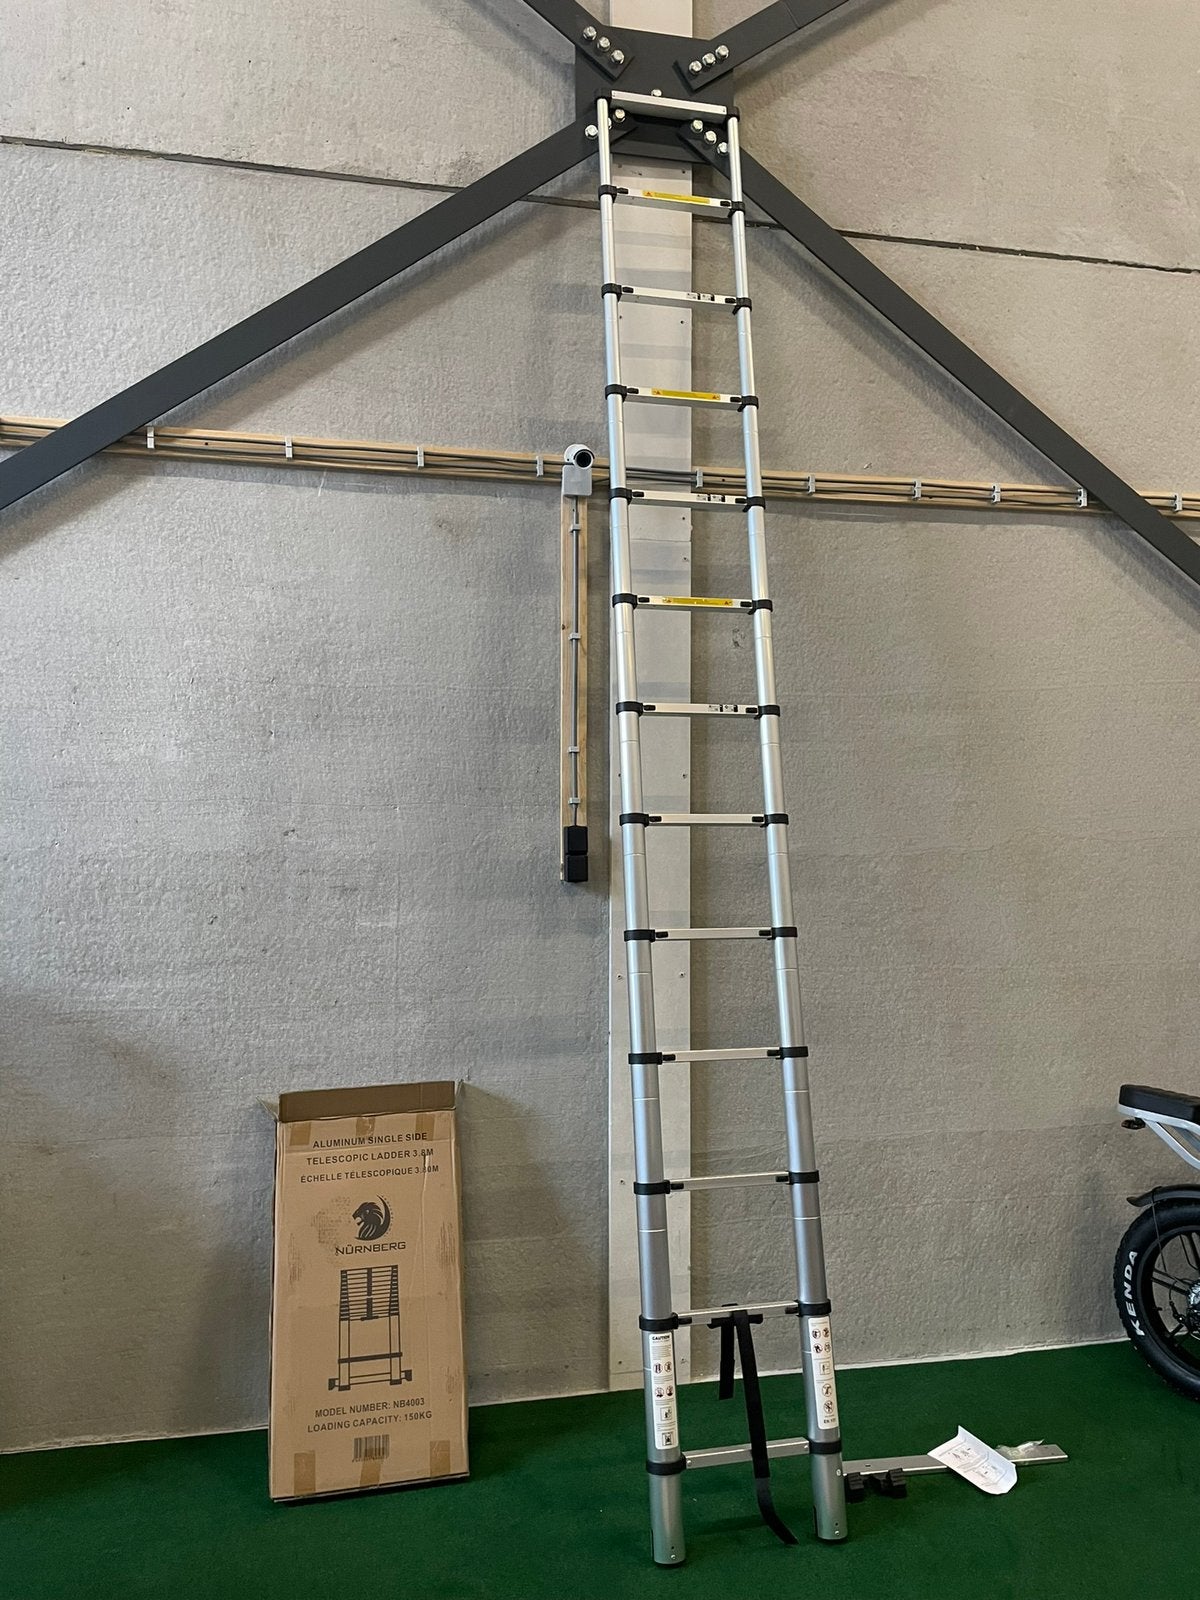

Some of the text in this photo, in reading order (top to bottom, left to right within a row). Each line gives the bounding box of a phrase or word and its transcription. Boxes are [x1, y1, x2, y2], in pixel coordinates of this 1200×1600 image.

[312, 1132, 428, 1149] ALUMINUM SINGLE SIDE
[307, 1154, 369, 1166] TELESCOPIC
[371, 1150, 411, 1161] LADDER
[336, 1241, 406, 1256] NÜRNBERG
[1123, 1251, 1145, 1336] KENDA
[315, 1398, 425, 1418] MODEL NUMBER: NB4003
[307, 1411, 432, 1432] LOADING CAPACITY: 150KG
